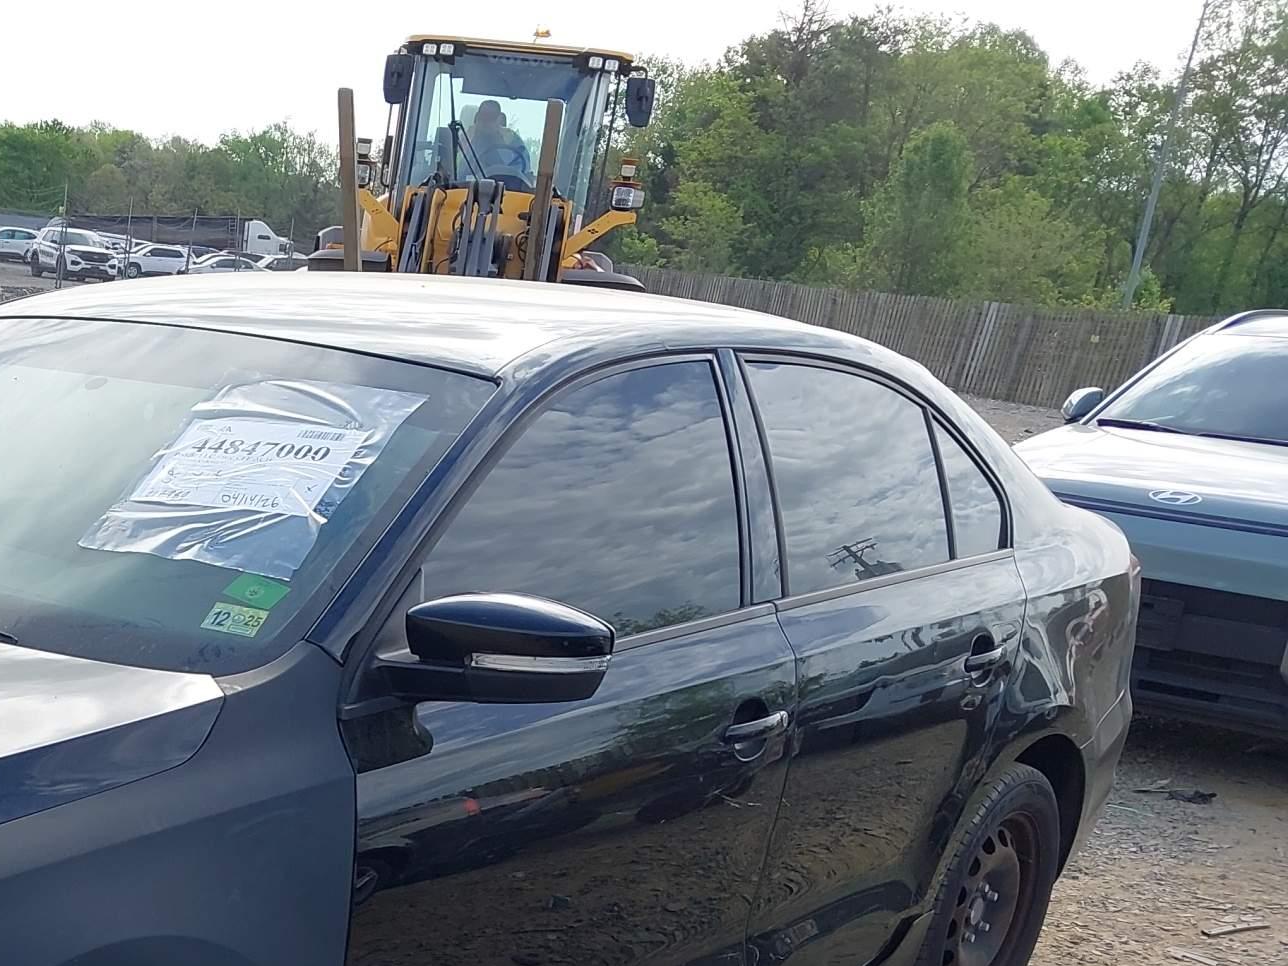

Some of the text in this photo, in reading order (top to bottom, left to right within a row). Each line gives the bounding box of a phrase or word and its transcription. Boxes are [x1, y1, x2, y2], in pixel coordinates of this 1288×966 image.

[191, 438, 331, 462] 44847000
[221, 493, 280, 508] 04/14/26
[211, 610, 263, 628] 12 25
